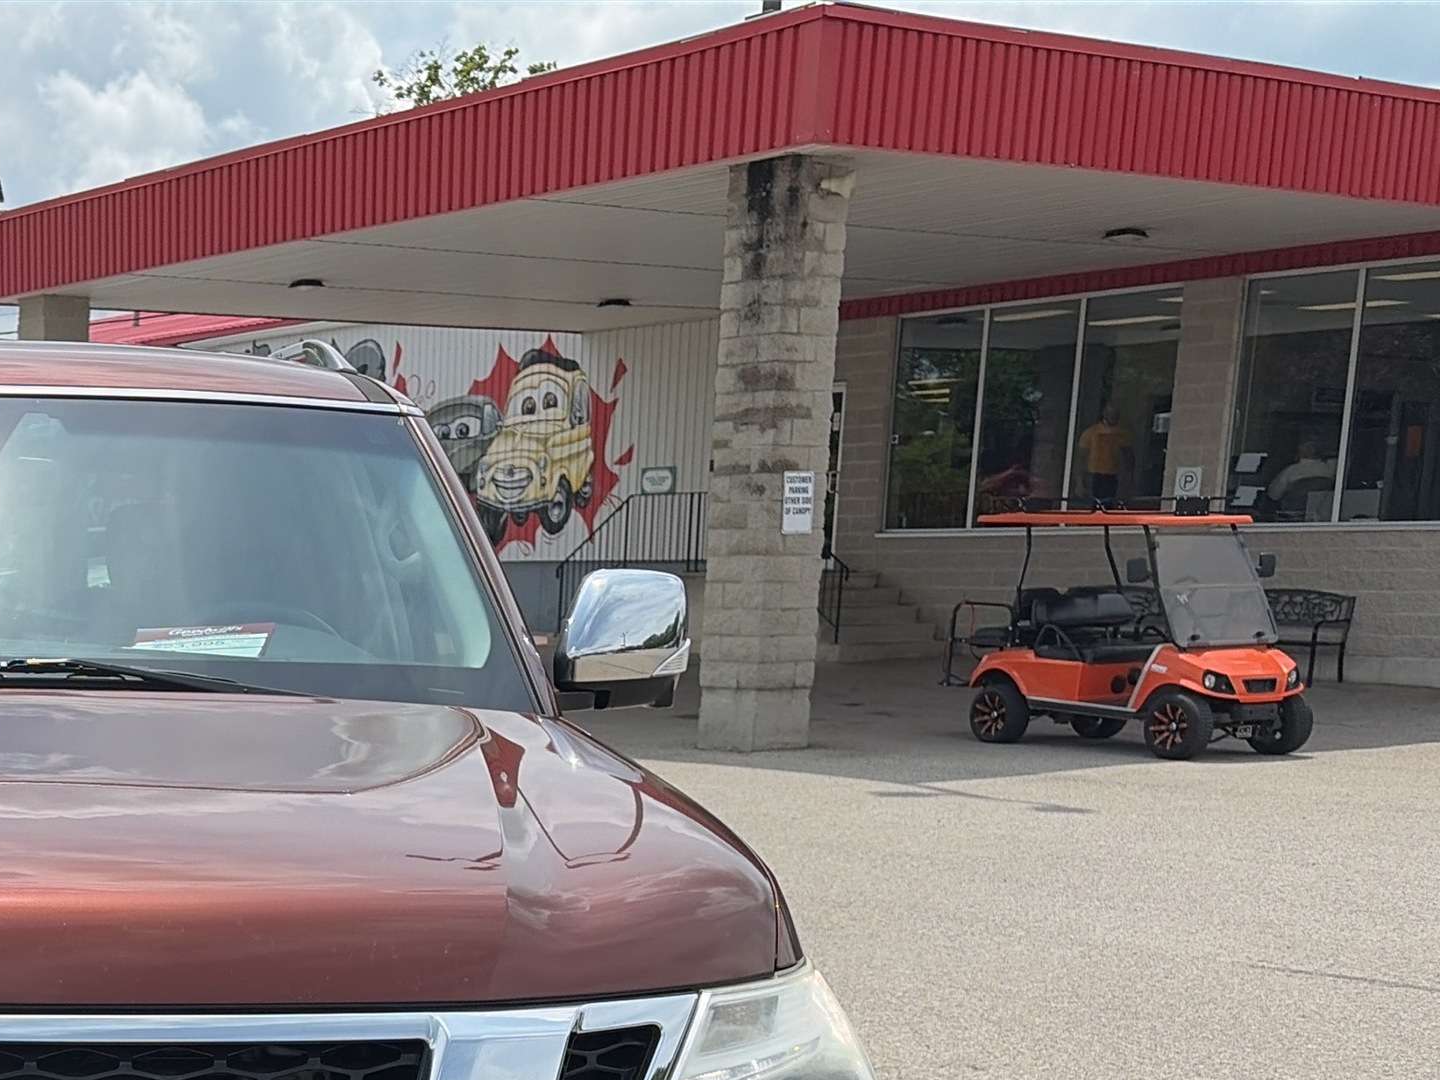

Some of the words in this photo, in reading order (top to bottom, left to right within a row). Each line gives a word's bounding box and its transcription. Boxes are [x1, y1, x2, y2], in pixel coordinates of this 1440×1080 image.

[786, 475, 812, 483] CUSTOMER
[788, 486, 809, 494] PARKING
[784, 496, 800, 504] OTHER
